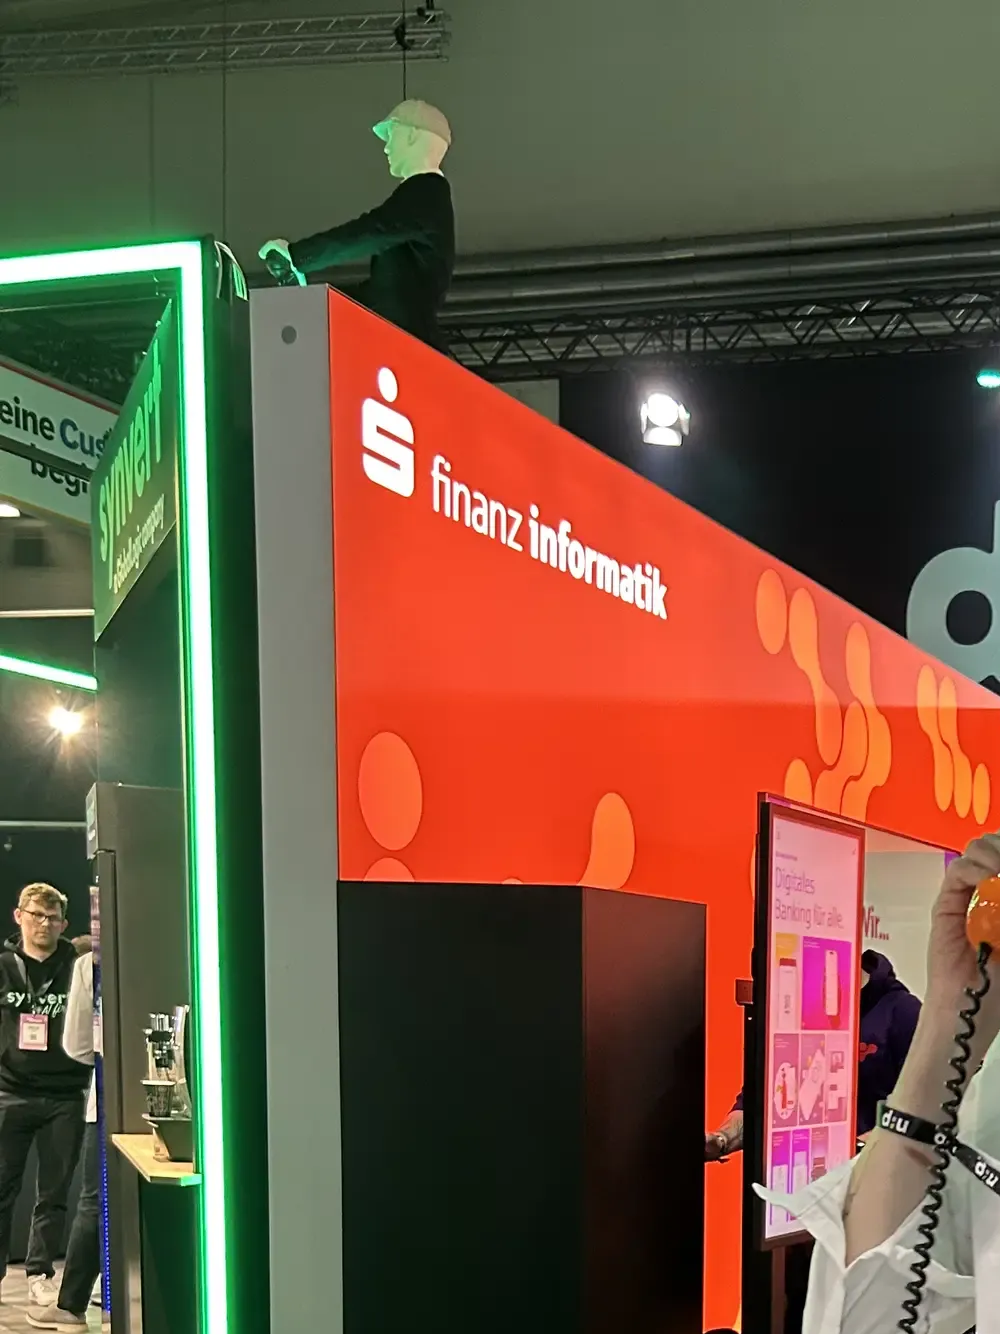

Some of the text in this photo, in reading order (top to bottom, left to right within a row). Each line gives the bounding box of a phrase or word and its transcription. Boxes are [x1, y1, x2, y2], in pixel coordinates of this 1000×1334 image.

[59, 417, 112, 459] Cus
[99, 338, 162, 590] synvert
[430, 454, 668, 620] finanz informatik
[775, 866, 815, 895] Digitales
[775, 898, 811, 929] Banking
[7, 991, 69, 1007] syver
[881, 1110, 910, 1134] d:u
